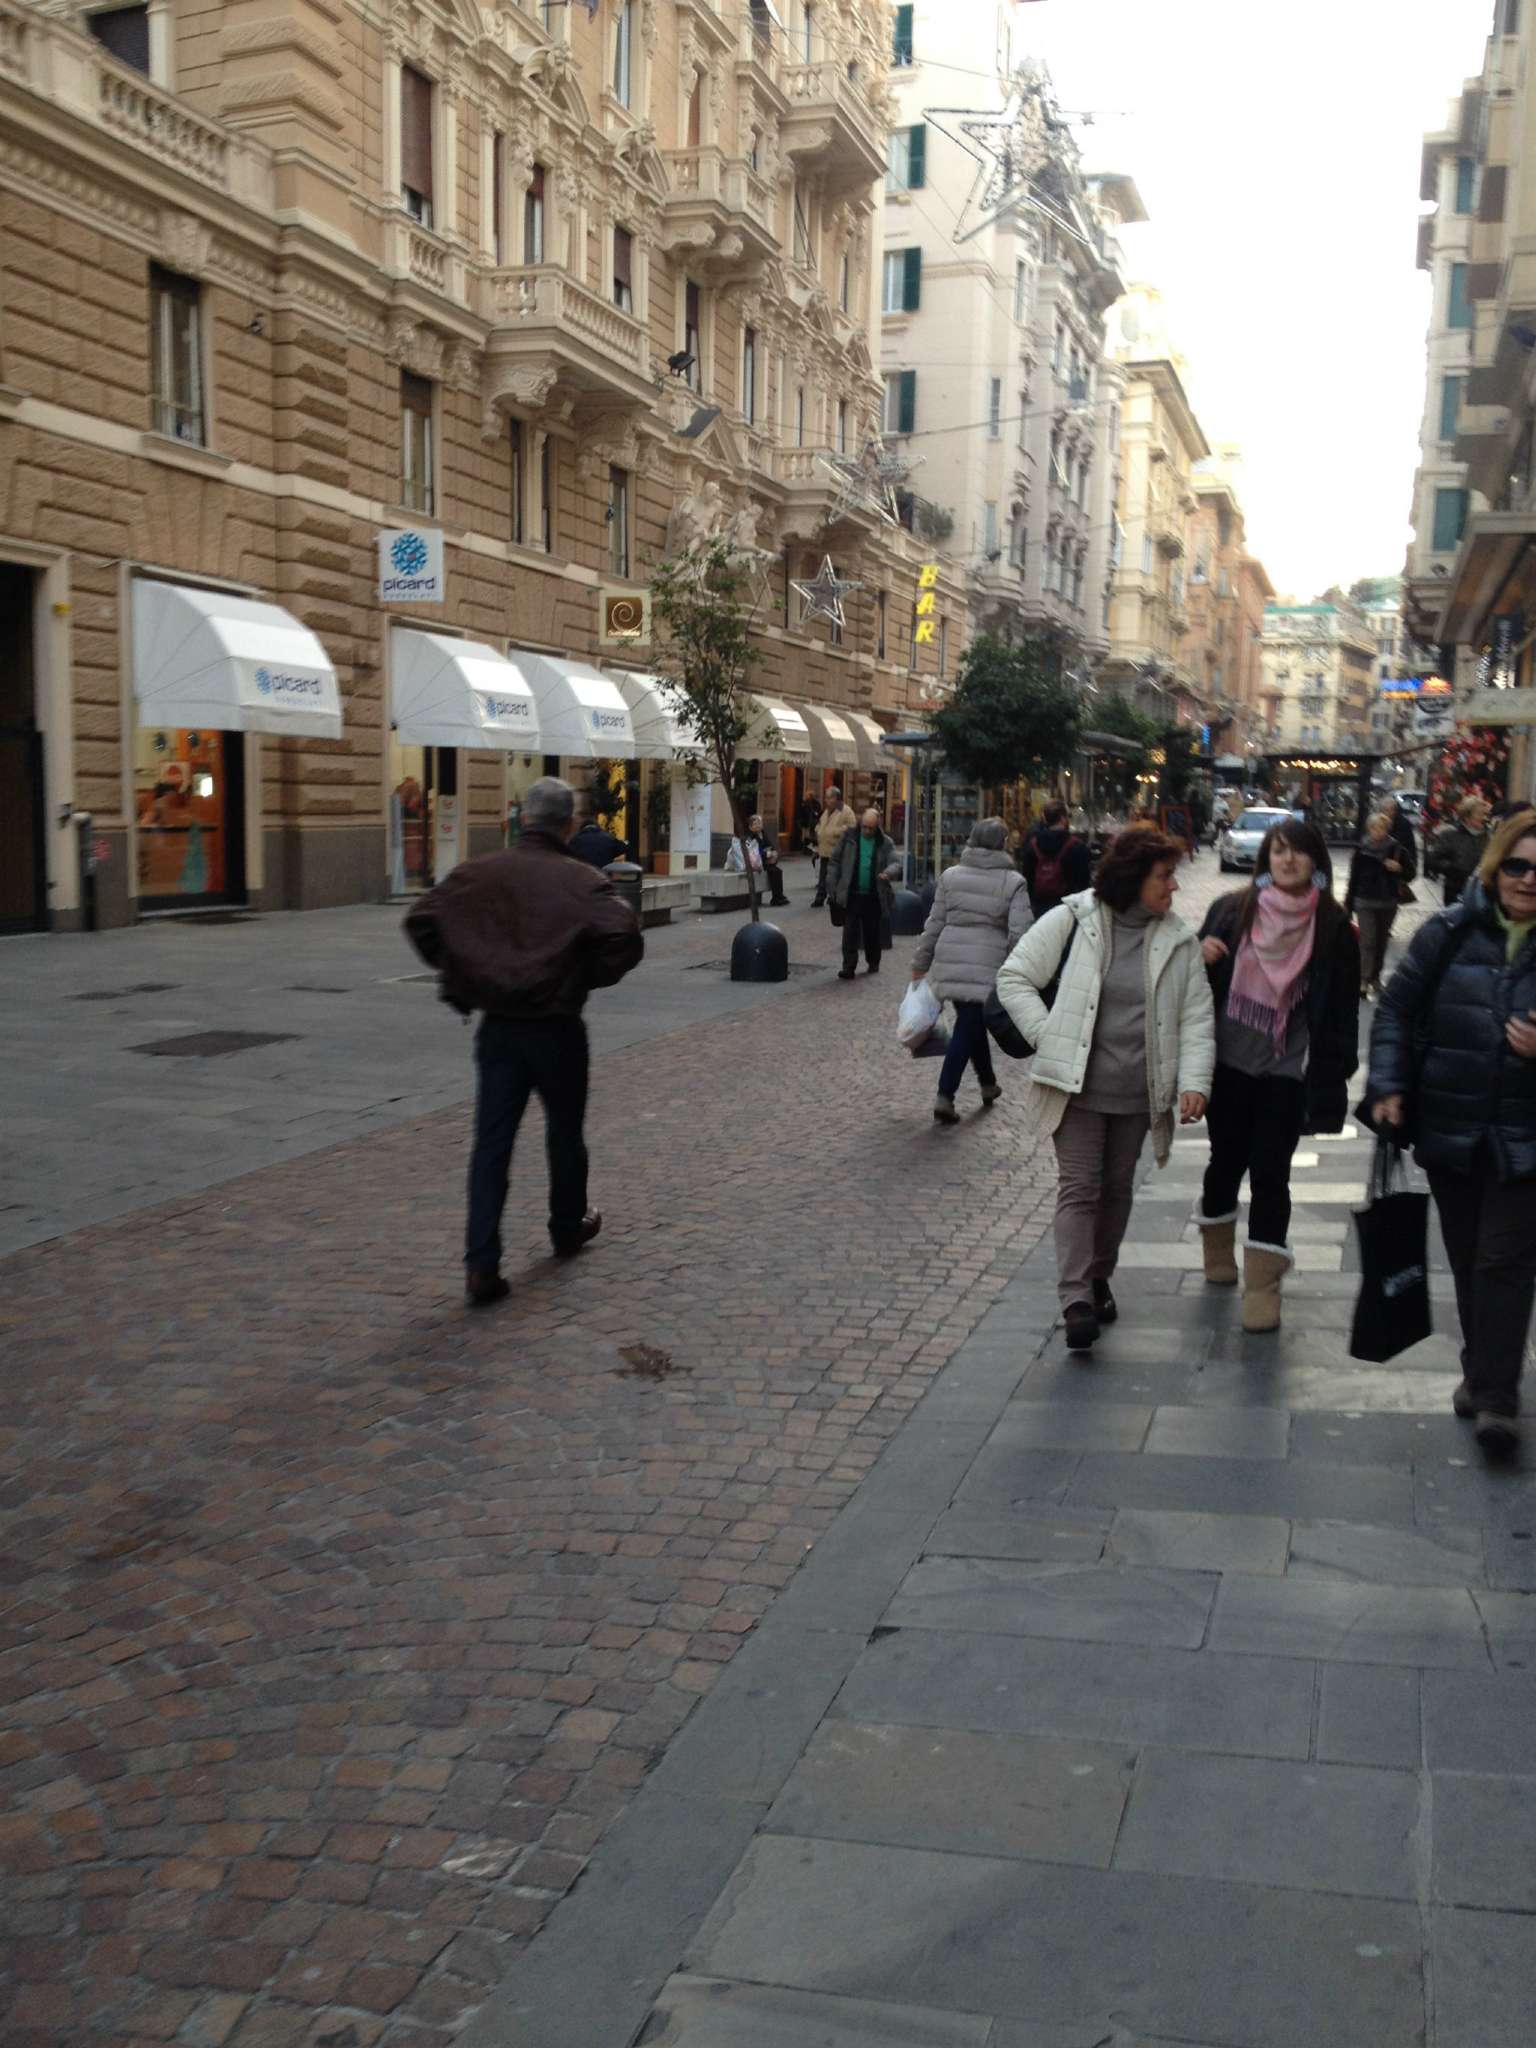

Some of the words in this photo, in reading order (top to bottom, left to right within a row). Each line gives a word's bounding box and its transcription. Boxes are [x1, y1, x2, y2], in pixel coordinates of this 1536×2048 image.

[383, 577, 435, 593] picard
[914, 564, 939, 643] BAR
[271, 674, 322, 695] picard
[496, 701, 529, 717] picard
